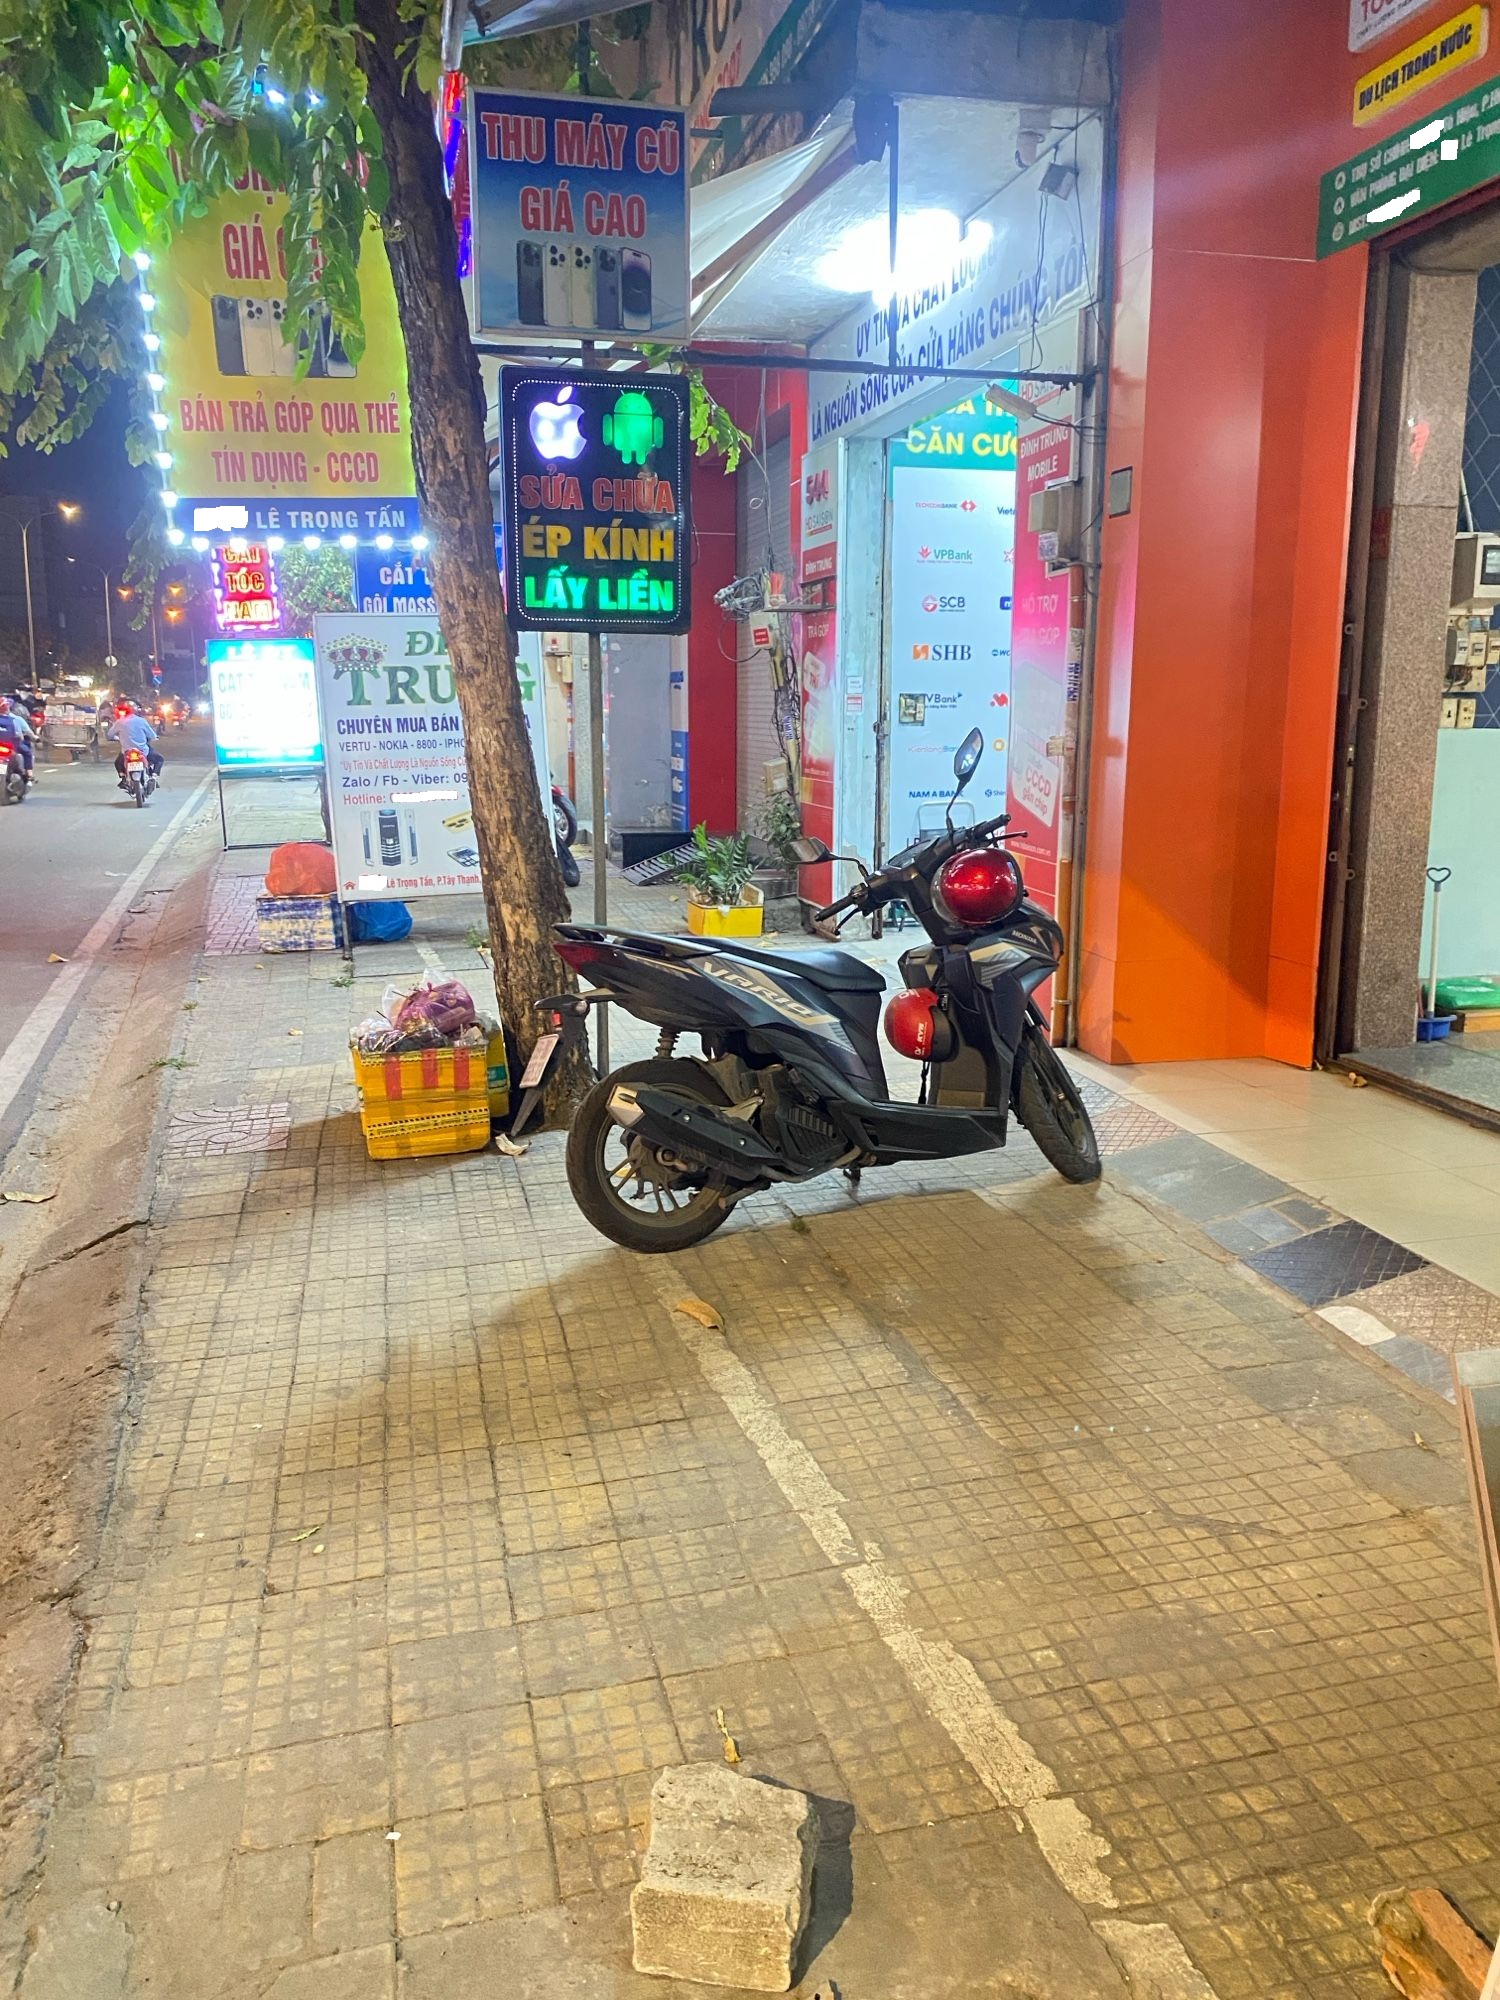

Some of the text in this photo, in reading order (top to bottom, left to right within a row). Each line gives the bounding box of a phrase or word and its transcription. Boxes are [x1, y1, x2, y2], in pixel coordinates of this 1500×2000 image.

[1358, 22, 1473, 111] DU LỊCH TRONG NƯỚC
[481, 112, 546, 164] THU
[554, 113, 629, 171] MÁY
[635, 120, 680, 176] CŨ
[1460, 130, 1473, 150] Lê
[519, 179, 647, 239] GIÁ CAO
[221, 213, 272, 281] GIÁ
[811, 401, 822, 442] LÀ
[824, 378, 858, 435] NGUỒN
[860, 370, 889, 416] SỐNG
[917, 325, 943, 382] CỬA
[947, 308, 985, 366] HÀNG
[989, 266, 1048, 340] CHÚNG
[856, 319, 871, 358] UY
[179, 390, 401, 437] BÁN TRẢ GÓP QUA THẺ
[907, 425, 964, 456] CĂN
[1020, 426, 1069, 459] ĐÌNH TRUNG
[211, 445, 247, 483] TÍN
[251, 451, 308, 490] DỤNG
[326, 451, 380, 483] CCCD
[1027, 454, 1059, 482] MOBILE
[518, 463, 676, 514] SỬA CHỮA
[255, 504, 406, 532] LÊ TRỌNG TẤN
[521, 515, 675, 562] ÉP KÍNH
[933, 549, 973, 561] VPBank
[225, 567, 265, 593] TÓC
[524, 564, 674, 612] LẤY LIỀN
[939, 596, 966, 608] SCB
[404, 630, 450, 656] ĐI
[932, 644, 972, 661] SHB
[333, 663, 537, 706] TRUG
[922, 693, 957, 703] VBank
[336, 713, 460, 735] CHUYÊN MUA BÁN
[339, 741, 371, 752] VERTU
[379, 739, 409, 750] NOKIA
[416, 739, 437, 749] 8800
[342, 776, 371, 788] Zalo
[383, 775, 399, 786] Fb
[411, 773, 450, 785] Viber:
[1026, 767, 1052, 798] CCCD
[343, 793, 386, 806] Hotline:
[386, 878, 396, 889] Lê
[397, 877, 418, 890] Trọng
[420, 876, 436, 888] Tấn,
[437, 875, 456, 887] P.Tây
[1011, 930, 1038, 944] HONDA
[703, 961, 813, 1016] VARIO
